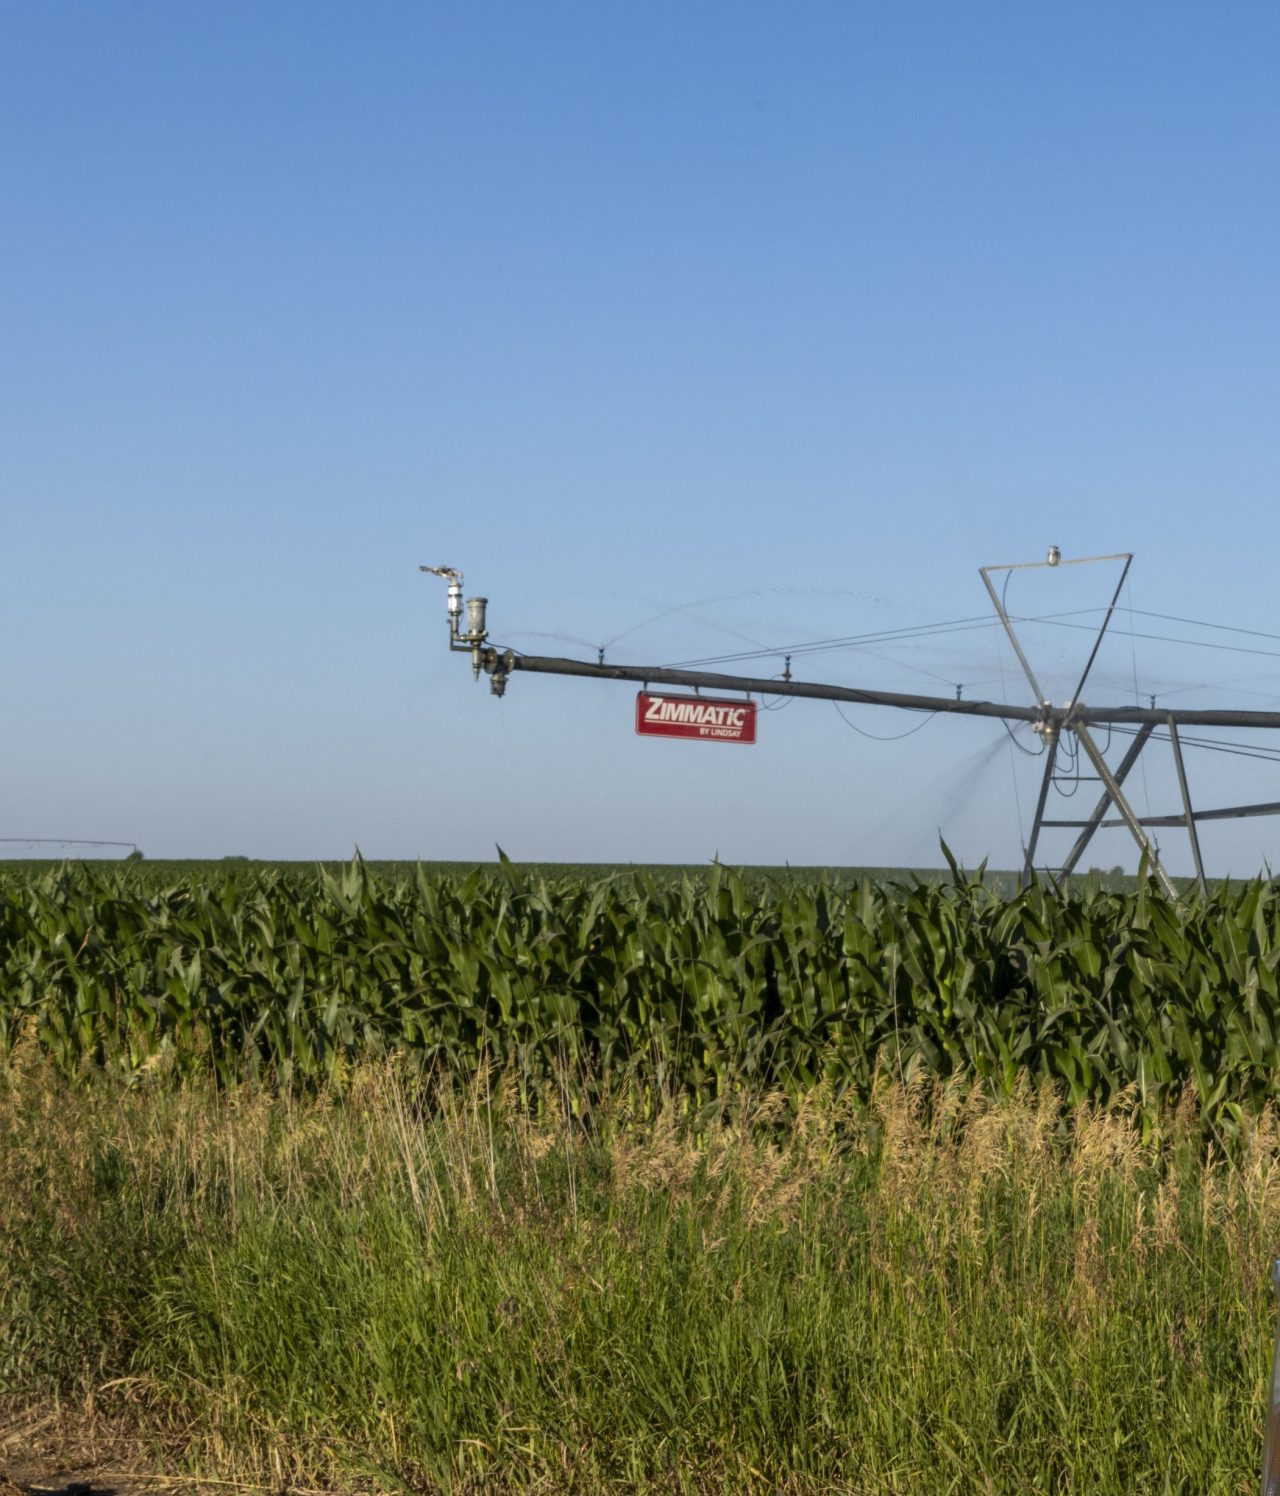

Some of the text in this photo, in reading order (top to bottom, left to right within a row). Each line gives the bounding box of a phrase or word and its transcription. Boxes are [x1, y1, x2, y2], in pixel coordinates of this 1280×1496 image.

[645, 697, 744, 726] ZIMMATIC
[700, 727, 741, 737] BY LINDSAY
